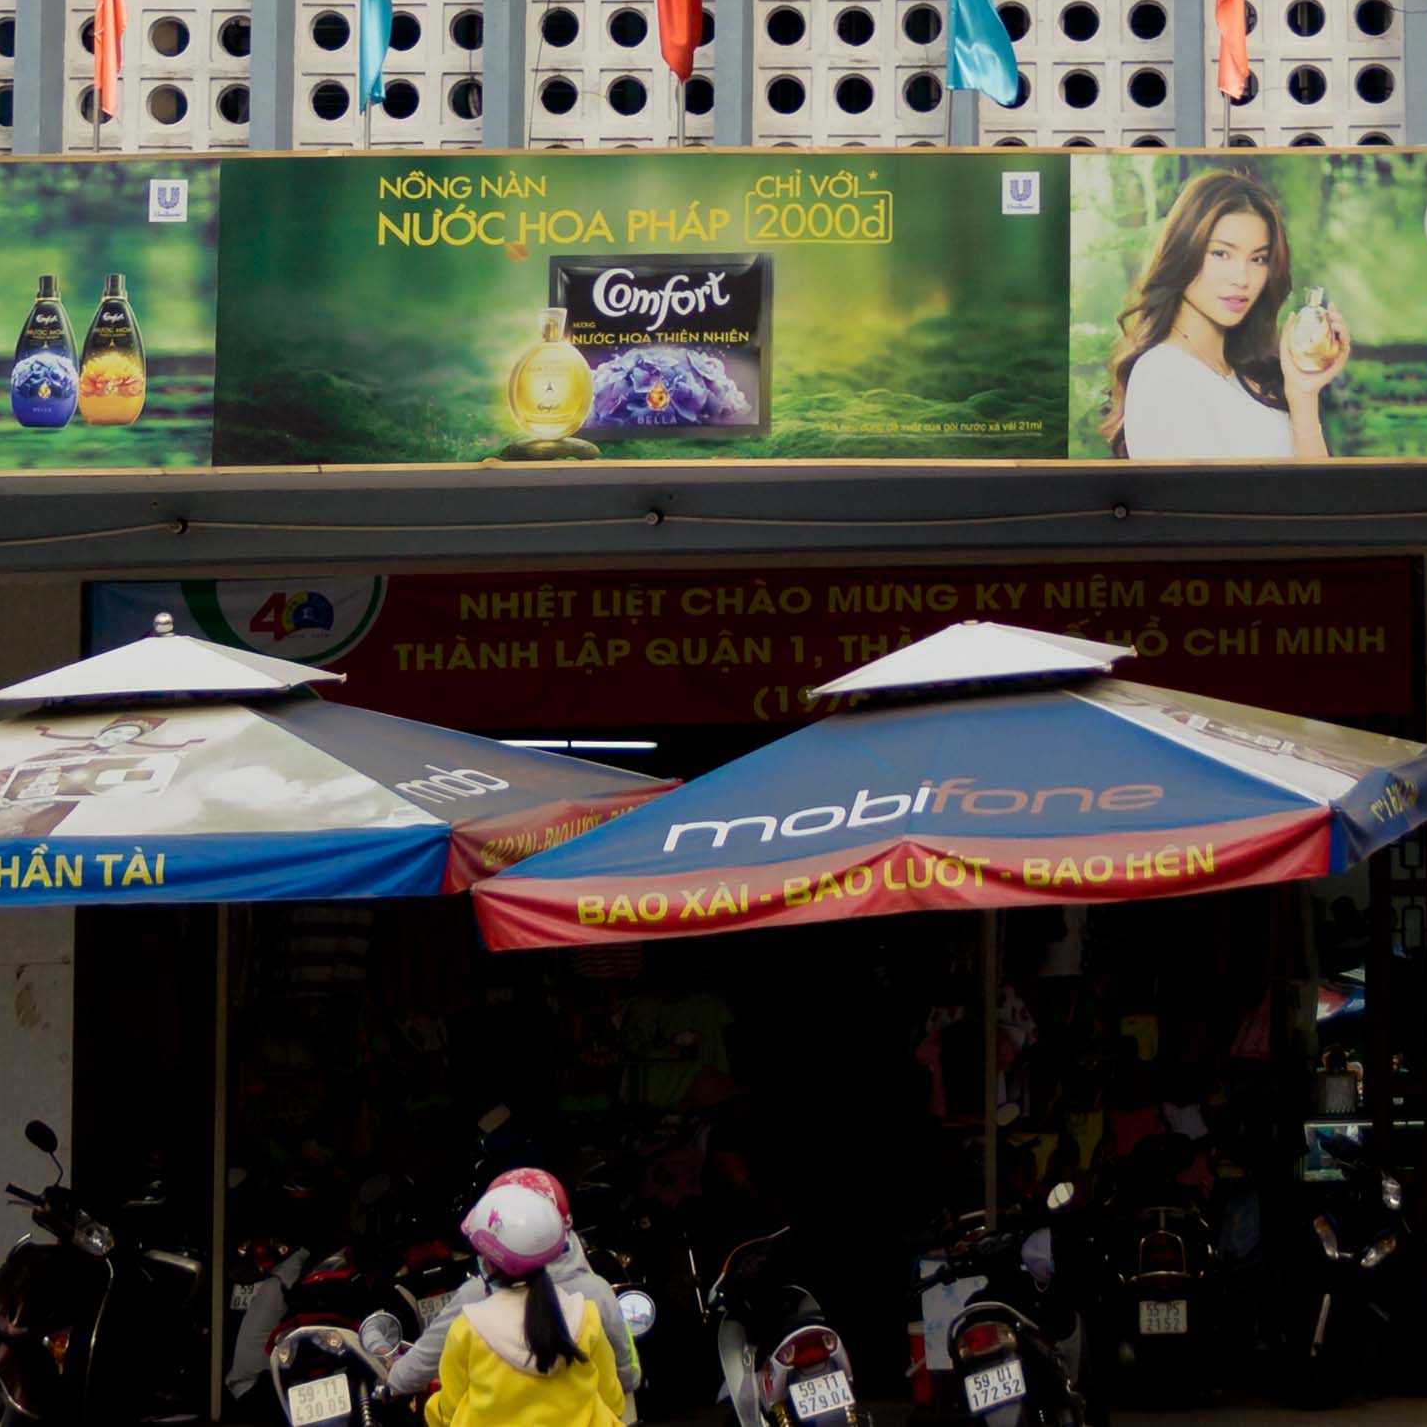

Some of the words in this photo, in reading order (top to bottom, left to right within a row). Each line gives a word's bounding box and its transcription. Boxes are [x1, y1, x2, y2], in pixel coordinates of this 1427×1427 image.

[379, 170, 472, 199] NỒNG
[480, 170, 547, 198] NÀN
[755, 169, 802, 199] CHỈ
[377, 203, 506, 247] NƯỚC
[518, 208, 615, 244] HOA
[627, 199, 731, 242] PHÁP
[755, 200, 886, 239] 2000đ
[592, 268, 731, 331] Comfort
[619, 333, 651, 344] HOA
[655, 329, 699, 343] THIÊN
[703, 328, 749, 342] NHIÊN
[459, 582, 578, 628] NHIỆT
[591, 582, 668, 626] LIỆT
[681, 578, 812, 616] CHÀO
[1044, 573, 1145, 617] NIỆM
[1158, 578, 1210, 608] 40
[393, 632, 540, 671] THÀNH
[555, 629, 631, 676] LẬP
[645, 629, 773, 674] QUẬN
[1182, 620, 1262, 657] CHÍ
[1275, 626, 1388, 657] MINH
[662, 782, 1165, 853] mobifone
[96, 845, 166, 887] TÀI
[576, 892, 669, 925] BAO
[679, 877, 751, 917] XÀI
[784, 867, 873, 906] BAO
[1022, 855, 1115, 886] BAO
